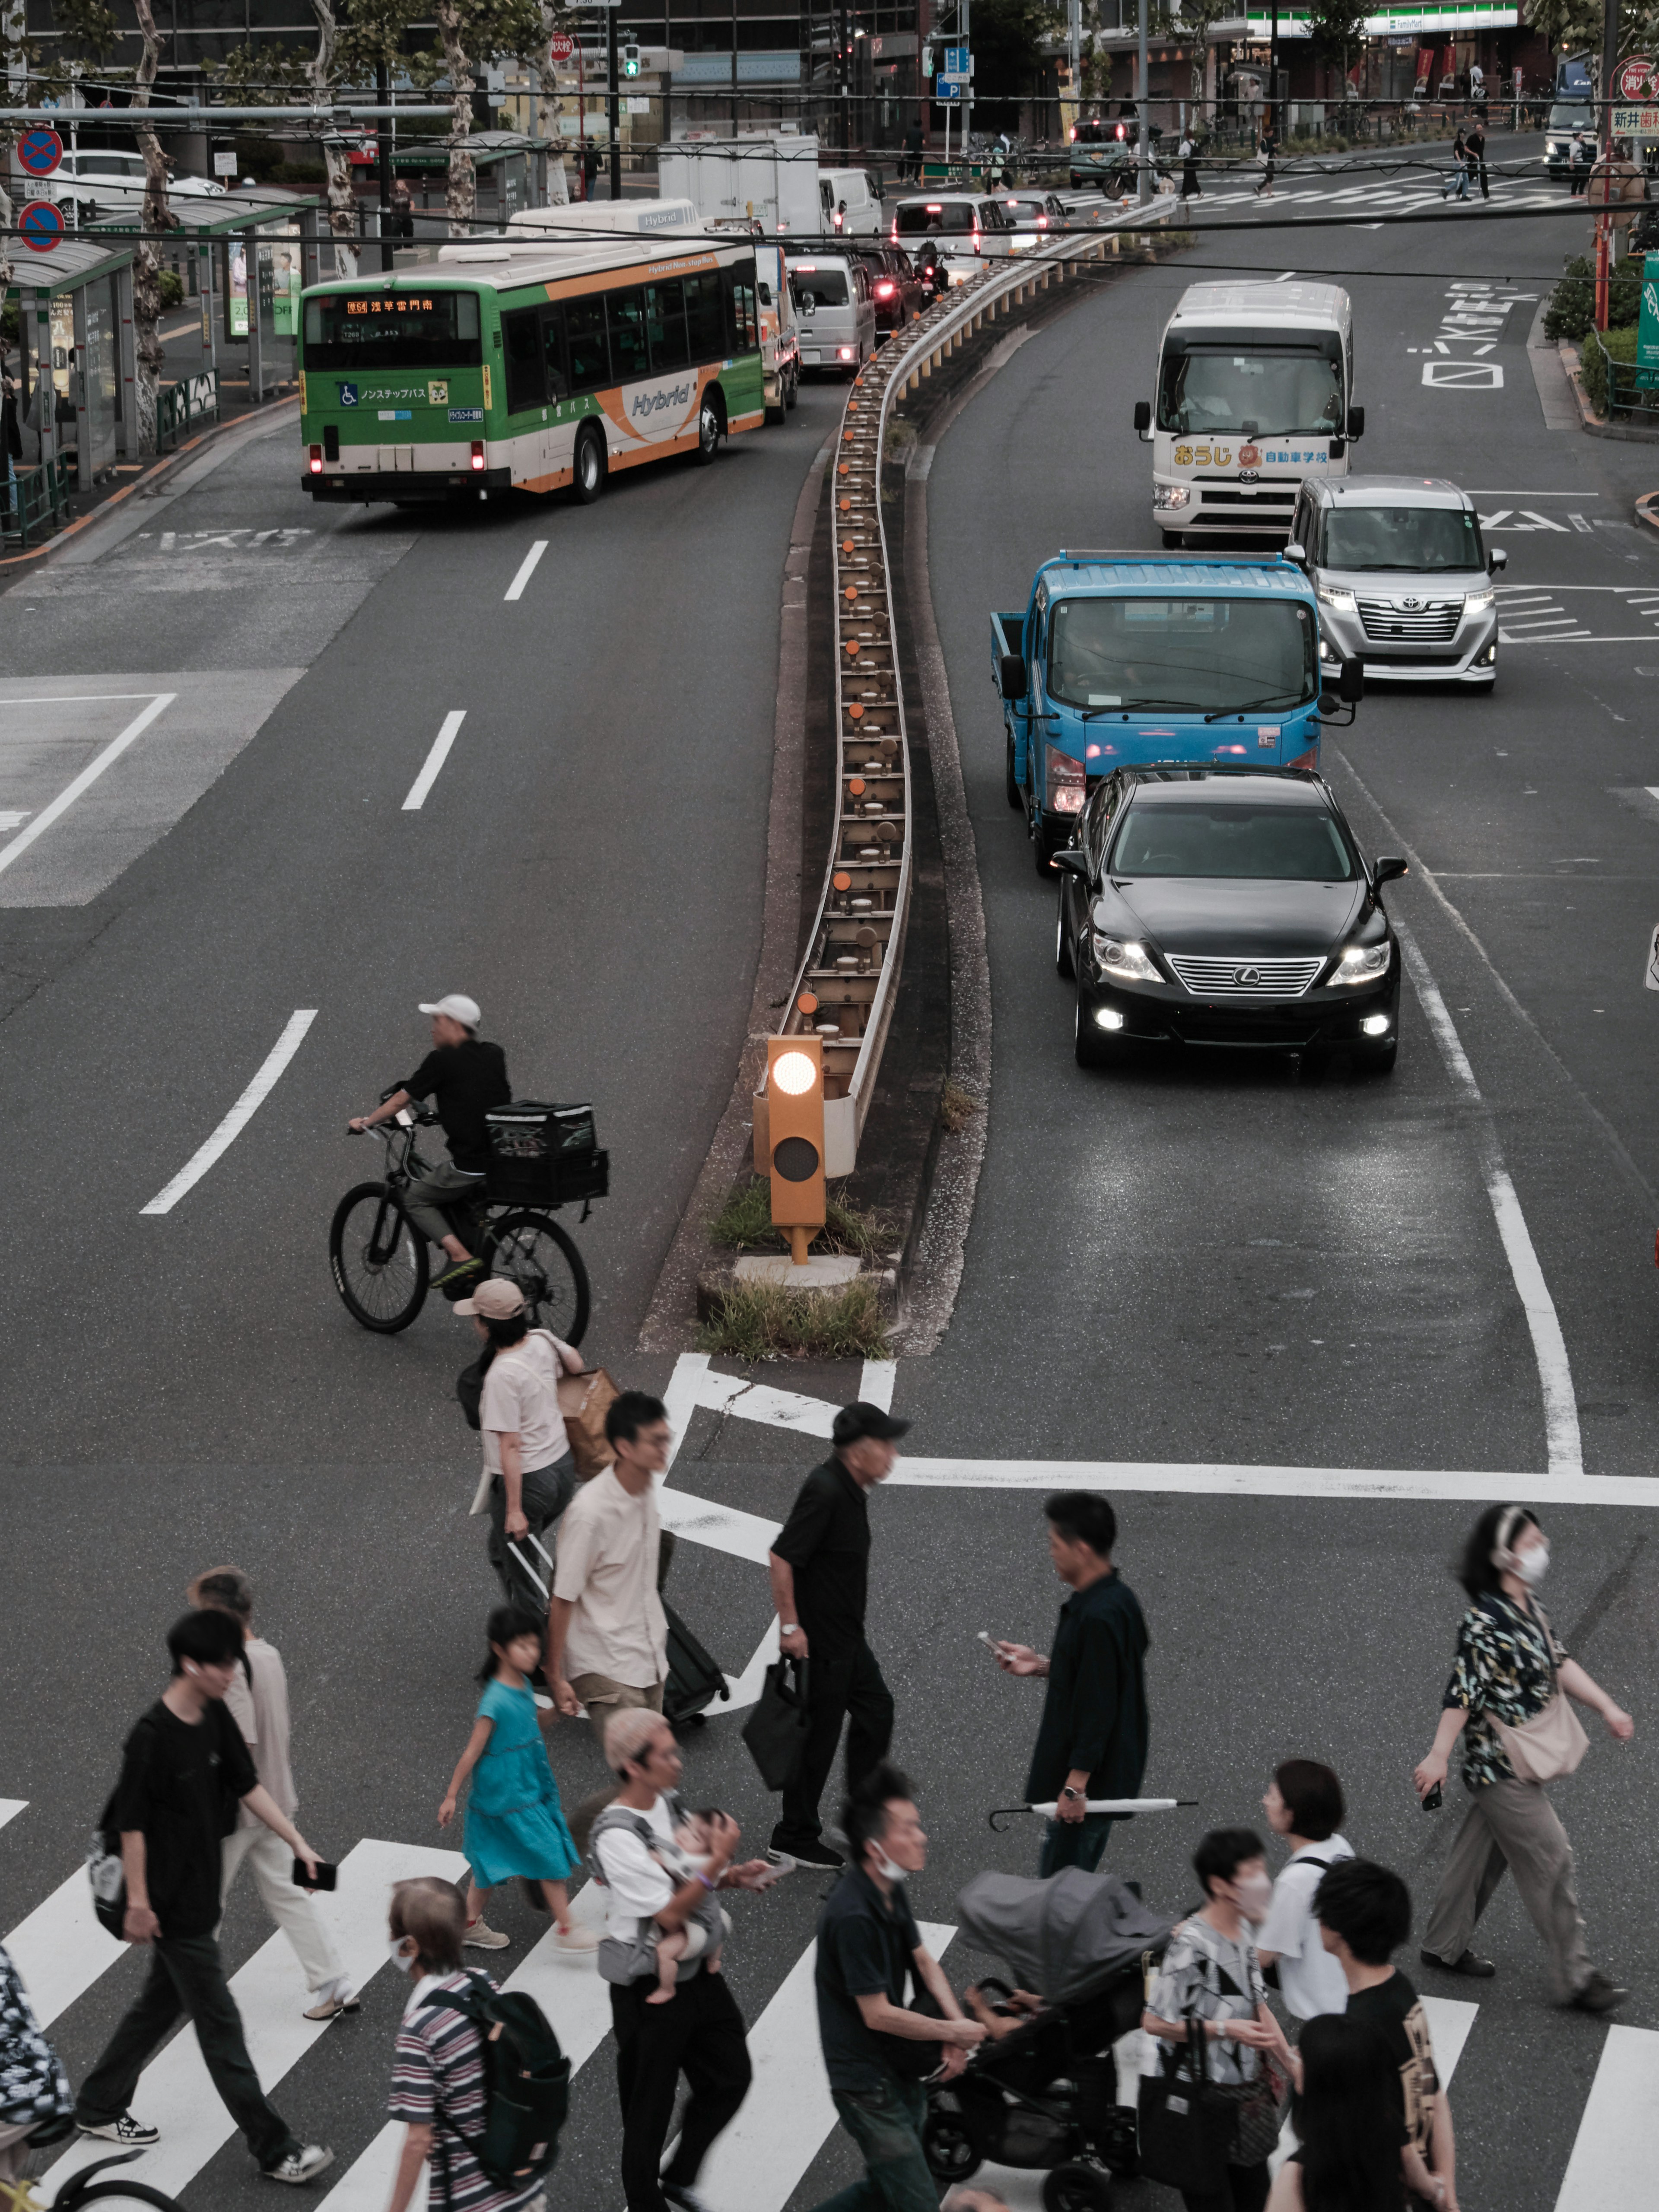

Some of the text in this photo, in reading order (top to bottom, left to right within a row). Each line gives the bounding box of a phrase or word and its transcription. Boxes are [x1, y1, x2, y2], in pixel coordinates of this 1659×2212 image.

[1397, 19, 1422, 29] FamilyMart
[950, 85, 958, 97] P
[645, 212, 676, 227] Hybrid
[649, 263, 672, 275] Hybrid
[702, 256, 713, 264] Bus
[350, 300, 432, 312] 草64 浅草雷門南
[361, 388, 426, 400] ノンステップバス
[632, 383, 690, 416] Hybrid
[1174, 445, 1327, 467] おうじ 自動車学校
